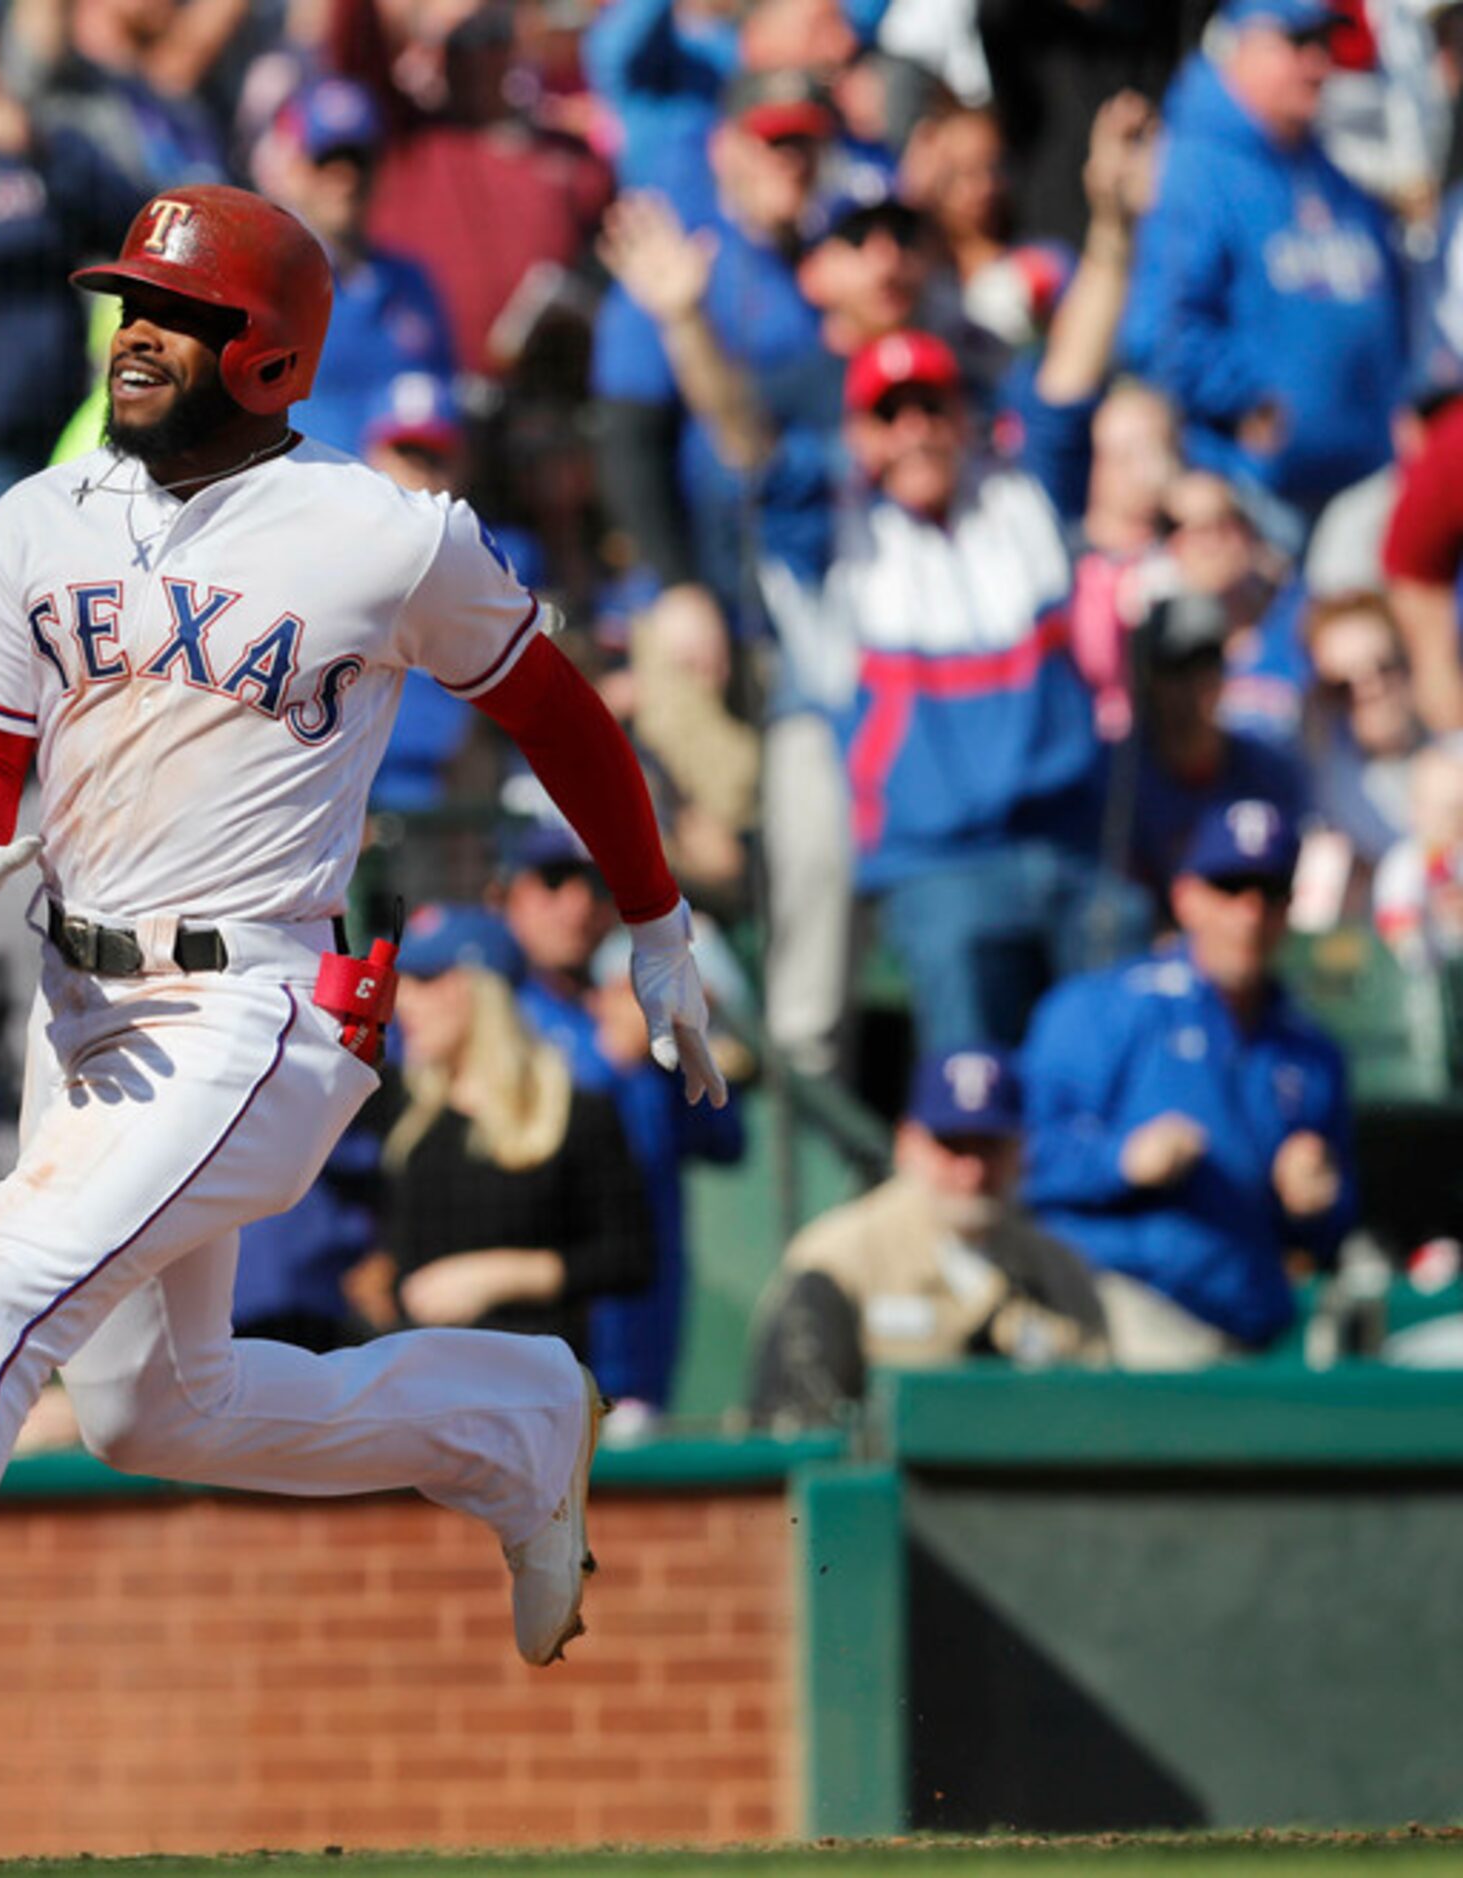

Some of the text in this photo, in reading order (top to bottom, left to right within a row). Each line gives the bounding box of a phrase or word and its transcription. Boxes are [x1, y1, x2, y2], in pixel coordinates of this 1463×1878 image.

[144, 200, 193, 254] T
[26, 576, 366, 747] TEXAS
[1224, 799, 1279, 857] T
[943, 1053, 999, 1112] T
